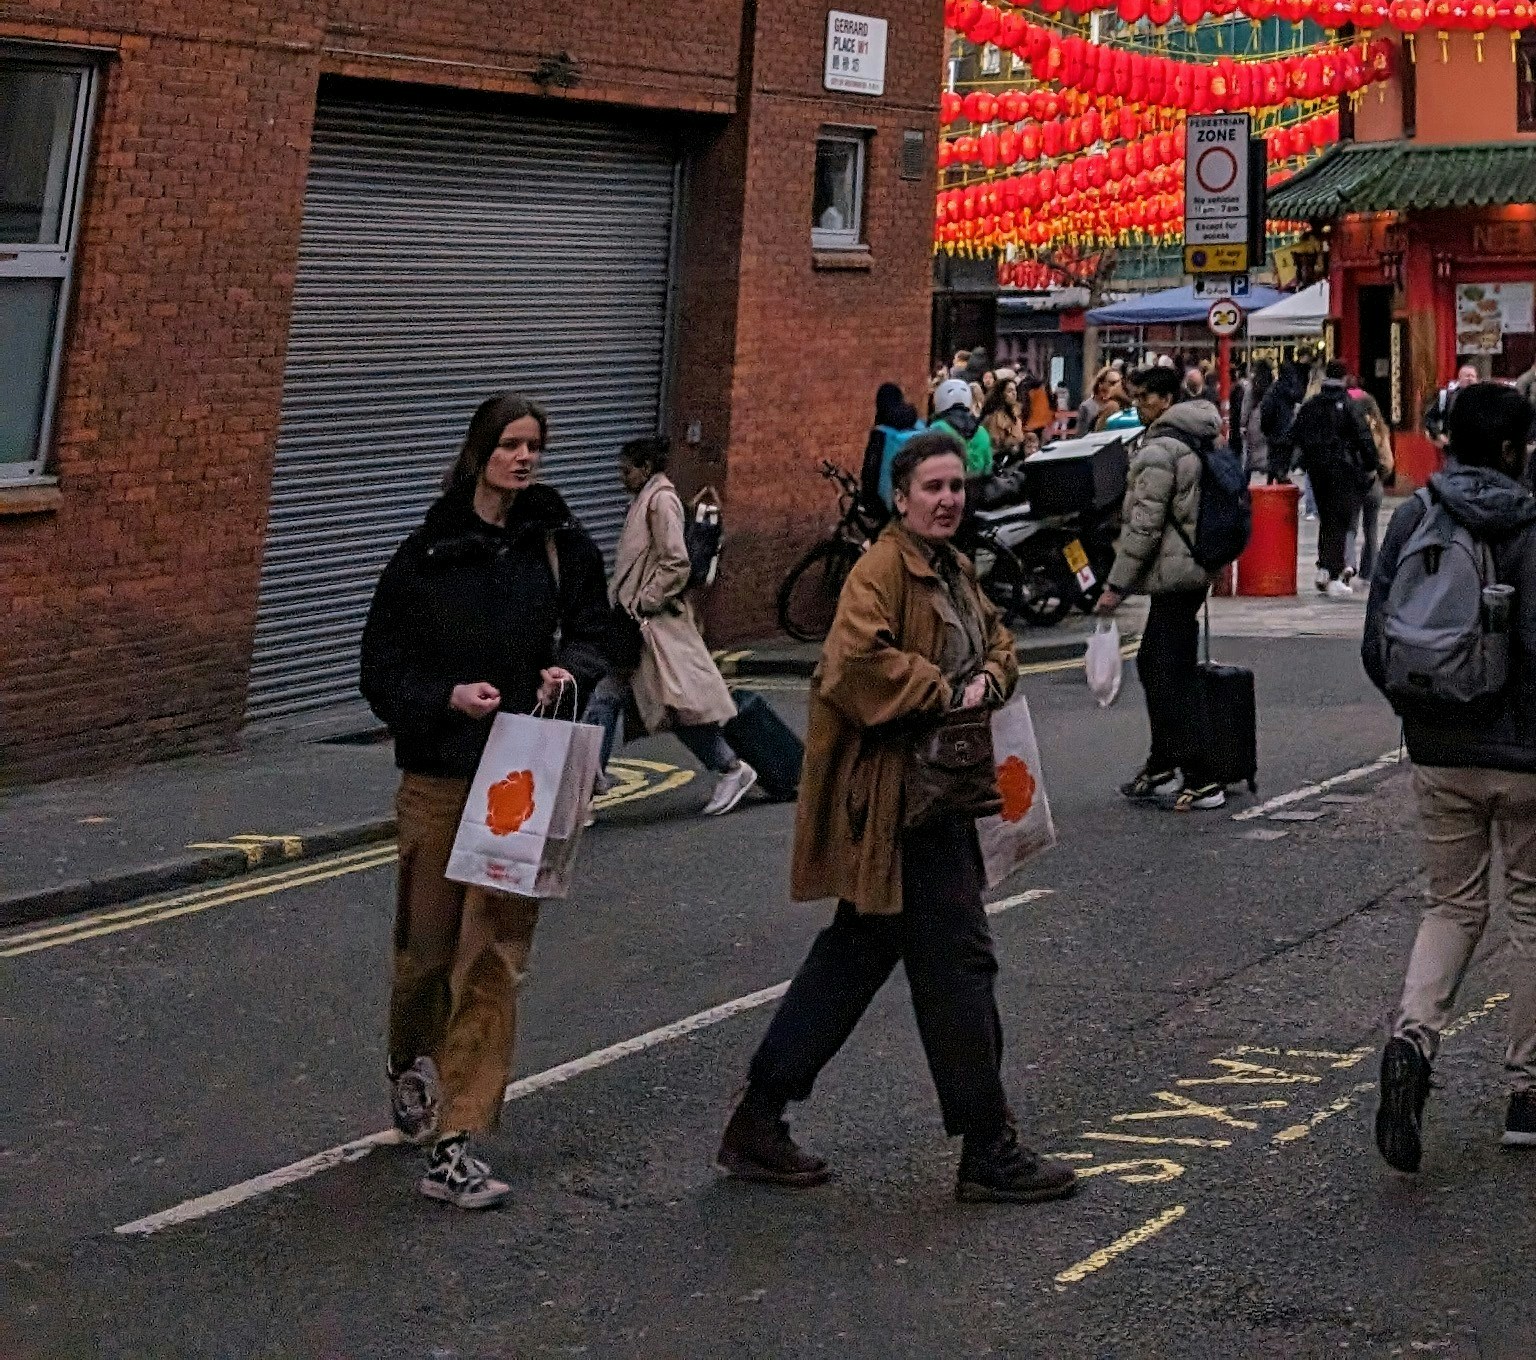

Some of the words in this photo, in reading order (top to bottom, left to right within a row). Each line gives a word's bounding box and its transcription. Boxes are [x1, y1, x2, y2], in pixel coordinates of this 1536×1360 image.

[834, 17, 869, 37] GERRARD
[833, 36, 856, 53] PLACE
[857, 40, 869, 55] W1
[1189, 118, 1245, 128] PEDESTRIAN
[1197, 128, 1237, 143] ZONE
[1195, 223, 1222, 232] Except
